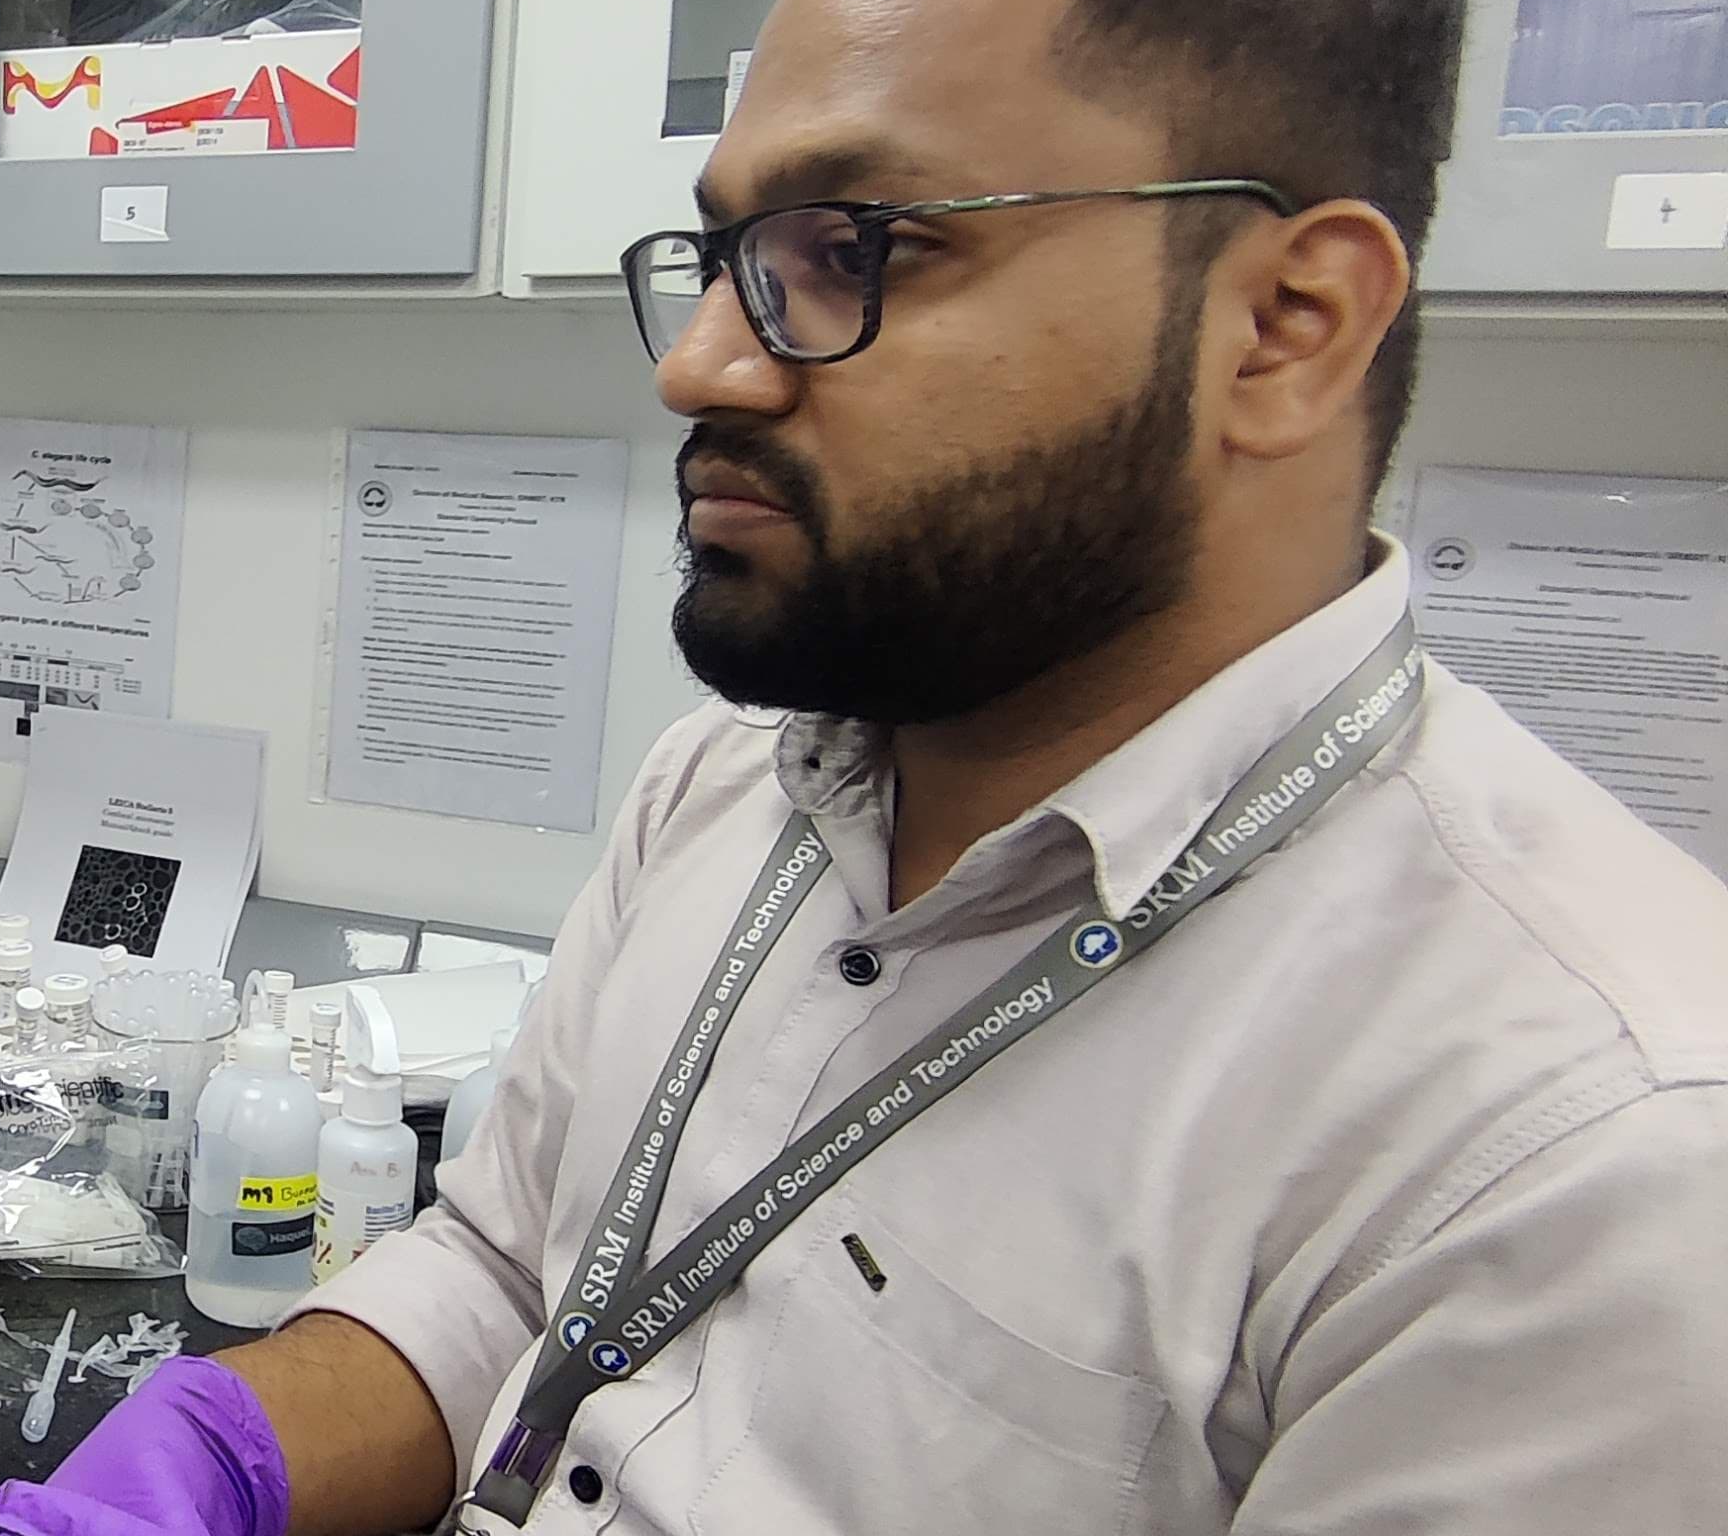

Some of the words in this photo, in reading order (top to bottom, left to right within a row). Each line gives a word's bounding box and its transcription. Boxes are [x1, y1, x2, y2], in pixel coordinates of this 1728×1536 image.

[125, 206, 137, 221] 5
[108, 797, 134, 809] LEICA
[1207, 764, 1316, 856] Institute
[1313, 730, 1343, 770] of
[1334, 667, 1410, 744] Science
[582, 1226, 631, 1309] SRM
[614, 1128, 665, 1226] Institute
[658, 1098, 677, 1127] of
[668, 1007, 720, 1099] Science
[715, 957, 747, 1002] and
[734, 831, 825, 952] Technology
[241, 1185, 274, 1205] M9
[621, 1282, 688, 1351] SRM
[677, 1214, 756, 1293] Institute
[754, 1187, 781, 1223] of
[774, 1123, 865, 1201] Science
[865, 1080, 915, 1128] and
[909, 975, 1058, 1088] Technology
